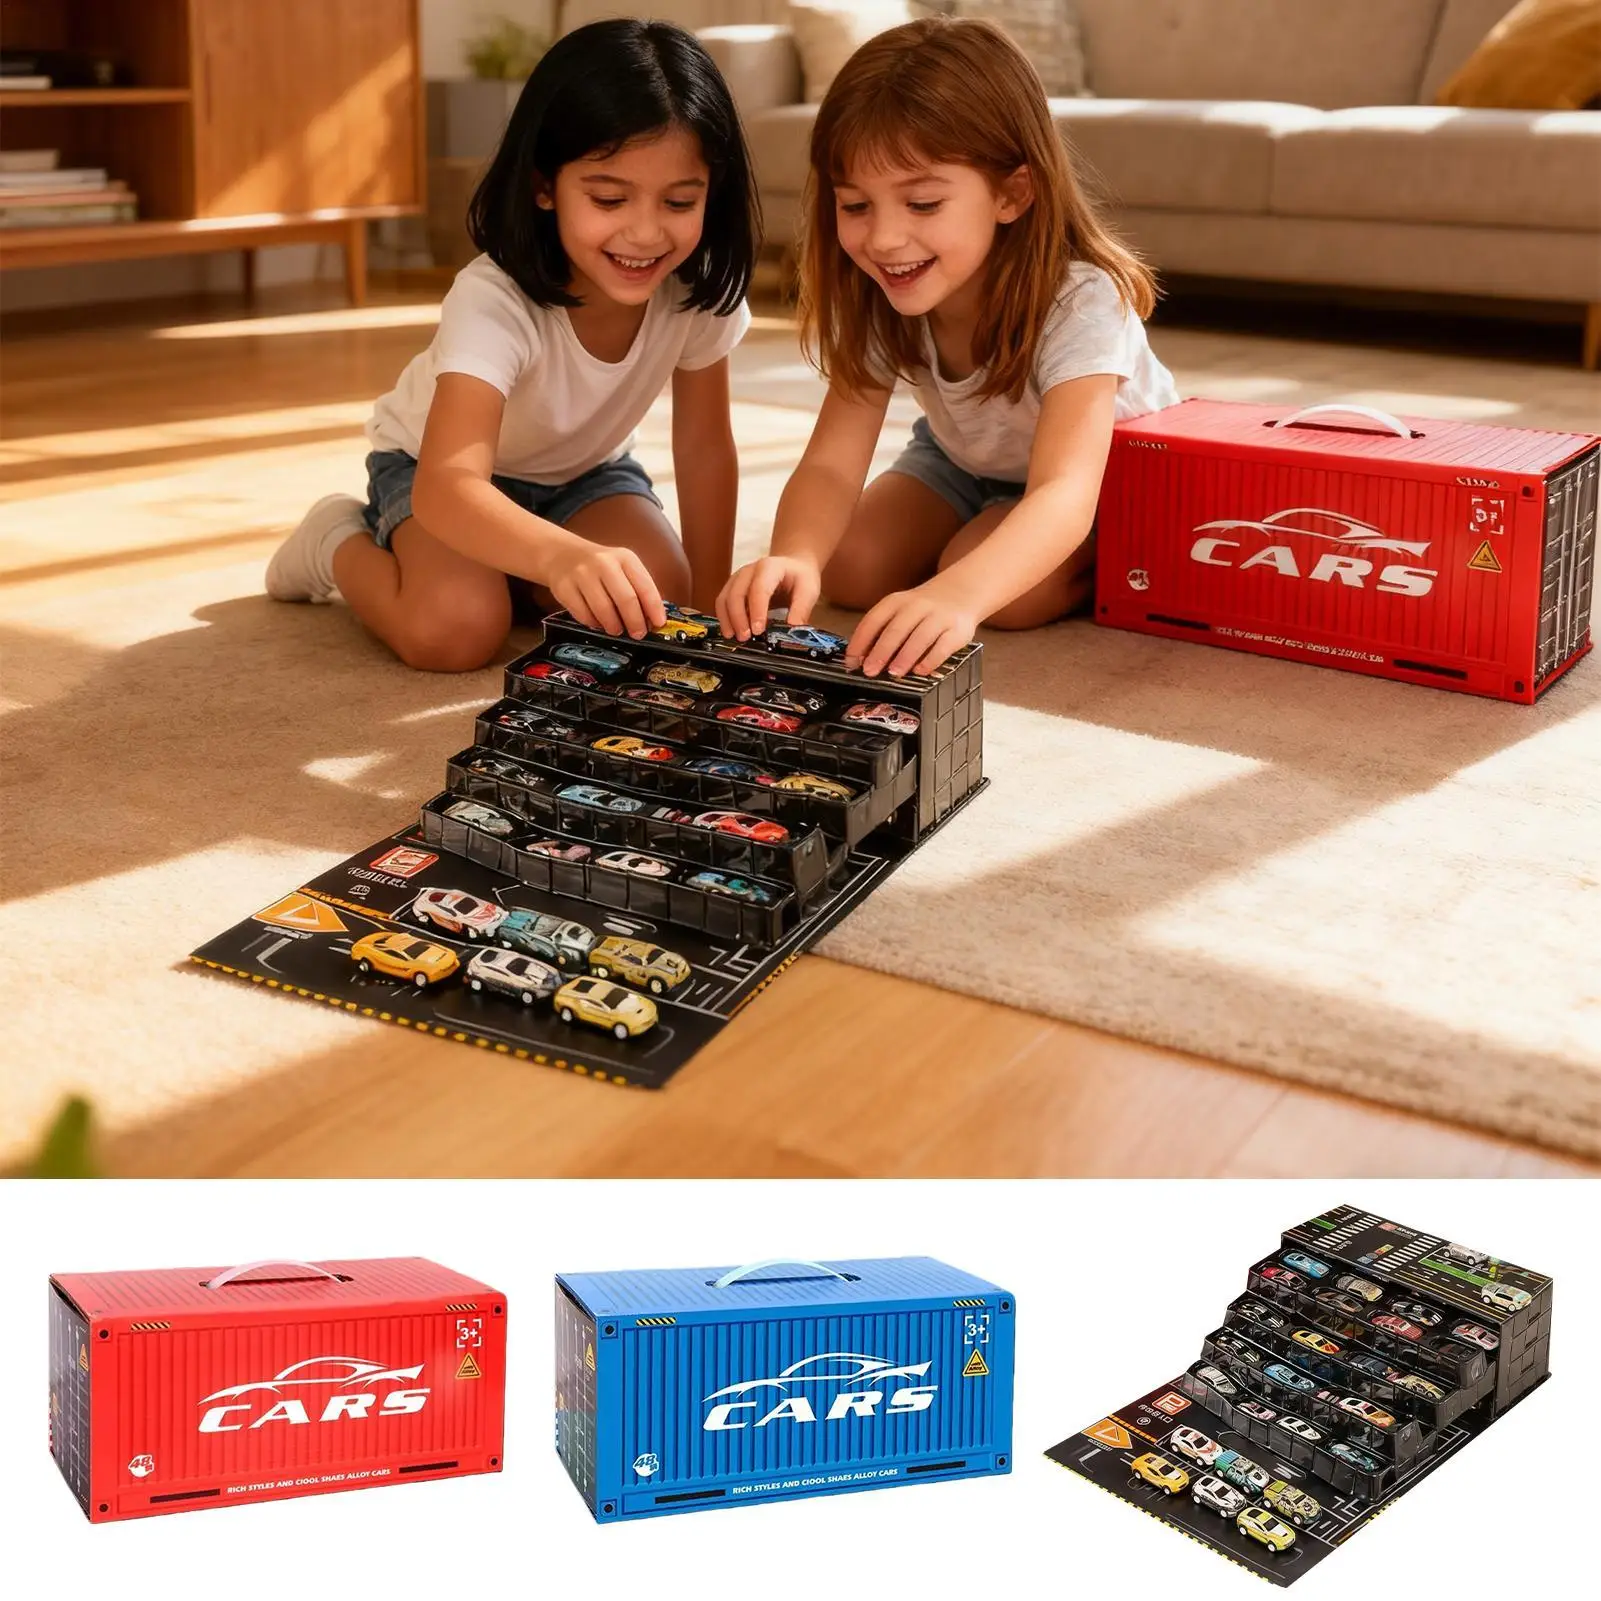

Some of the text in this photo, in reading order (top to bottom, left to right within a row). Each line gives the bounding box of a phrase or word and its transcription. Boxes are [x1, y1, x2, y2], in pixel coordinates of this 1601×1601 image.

[1190, 537, 1438, 597] CARS
[460, 1327, 478, 1341] 3+
[968, 1323, 986, 1337] 3+
[198, 1387, 431, 1433] CARS
[702, 1384, 939, 1431] CARS
[634, 1454, 656, 1468] 48
[227, 1486, 247, 1494] RICH
[248, 1482, 275, 1491] STYLES
[276, 1480, 294, 1488] AND
[347, 1471, 371, 1480] ALLOY
[371, 1468, 391, 1477] CARS
[733, 1468, 898, 1494] RICH STYLES AND CIOOL SHAES ALLOY CARS
